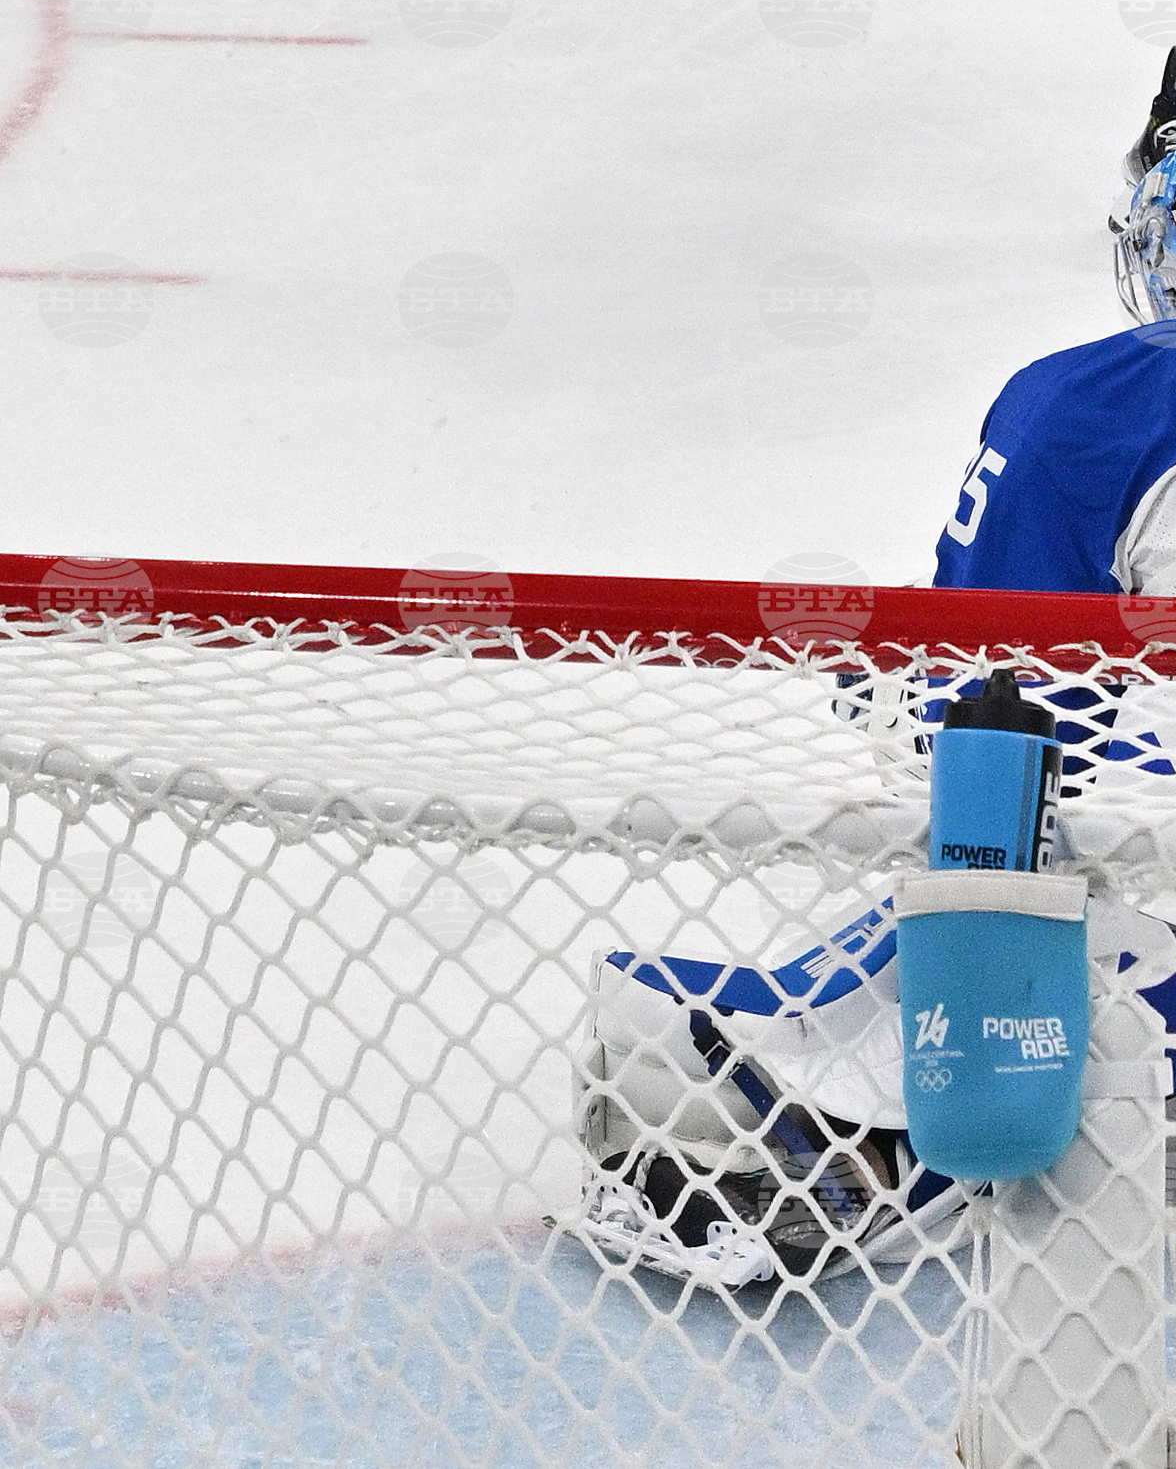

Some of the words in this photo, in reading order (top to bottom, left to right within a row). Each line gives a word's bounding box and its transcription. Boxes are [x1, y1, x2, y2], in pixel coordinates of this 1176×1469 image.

[941, 844, 1006, 864] POWER
[983, 1017, 1064, 1040] POWER
[1021, 1037, 1070, 1060] ADE
